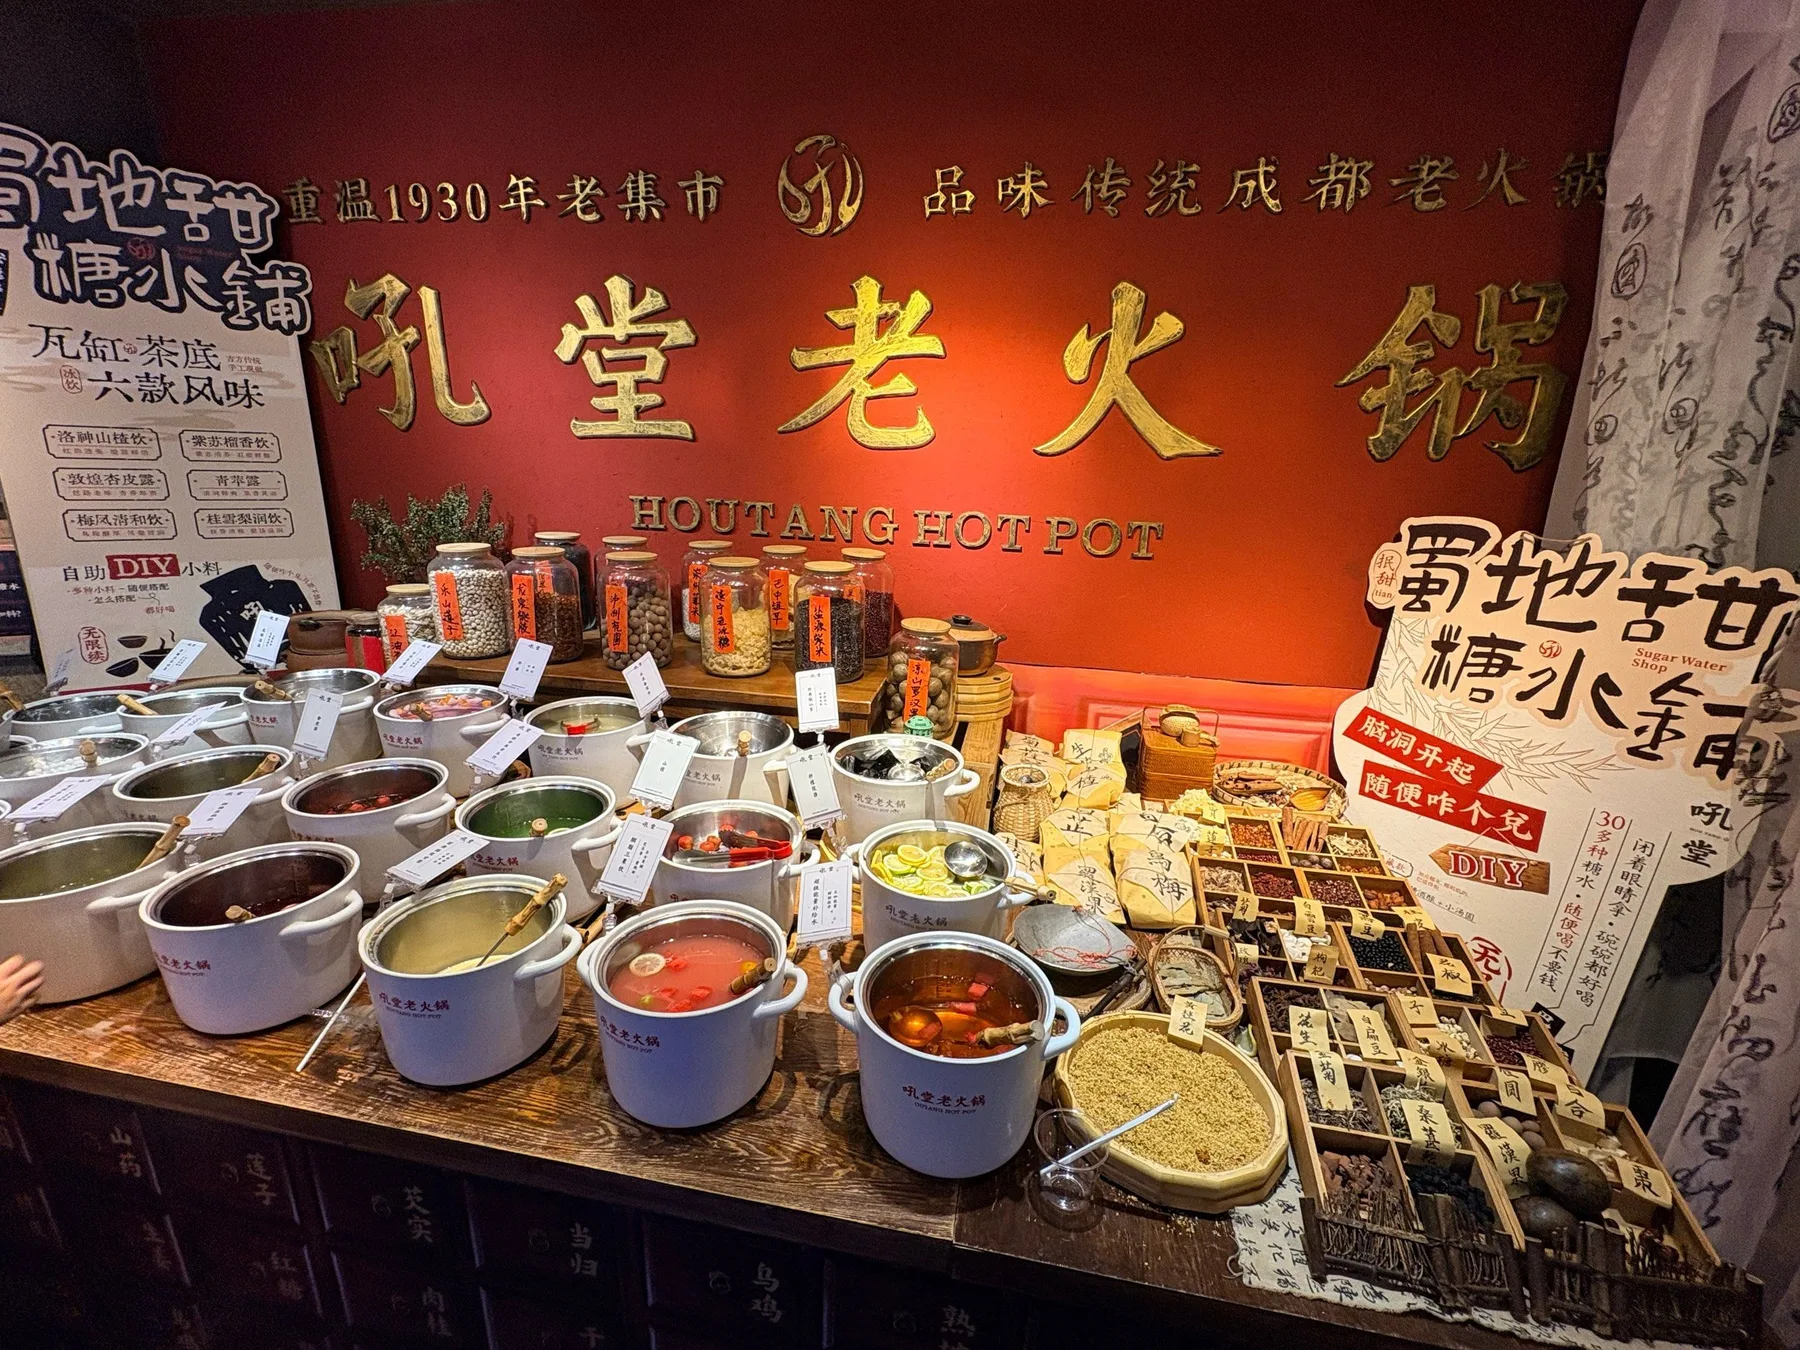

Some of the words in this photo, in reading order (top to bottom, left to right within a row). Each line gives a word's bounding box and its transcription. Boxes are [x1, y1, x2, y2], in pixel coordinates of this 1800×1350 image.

[283, 170, 724, 223] 重温1930年老集市
[310, 273, 1569, 472] 吼堂老火锅
[88, 371, 265, 408] 六款风味
[57, 431, 148, 445] 洛神山楂饮
[191, 435, 270, 449] 紫苏榴香饮
[67, 473, 156, 486] 敦煌杏皮露
[628, 495, 899, 545] HOUTANG
[912, 510, 1031, 553] HOT
[1043, 517, 1164, 561] POT
[63, 563, 105, 582] 自助
[114, 556, 174, 578] DIY
[182, 562, 223, 576] 小料
[1375, 589, 1393, 599] tian
[1632, 658, 1668, 674] Shop
[1635, 648, 1679, 663] Sugar
[1681, 655, 1727, 672] Water
[1358, 715, 1477, 786] 脑洞开起
[853, 792, 907, 809] 吼堂老火锅
[1450, 850, 1529, 889] DIY
[885, 903, 949, 927] 吼堂老火锅
[1311, 951, 1329, 977] 枸杞
[379, 991, 451, 1013] 吼堂老火锅
[902, 1084, 987, 1108] 吼堂老火锅
[569, 1221, 600, 1277] 当归
[752, 1261, 783, 1324] 乌鸡
